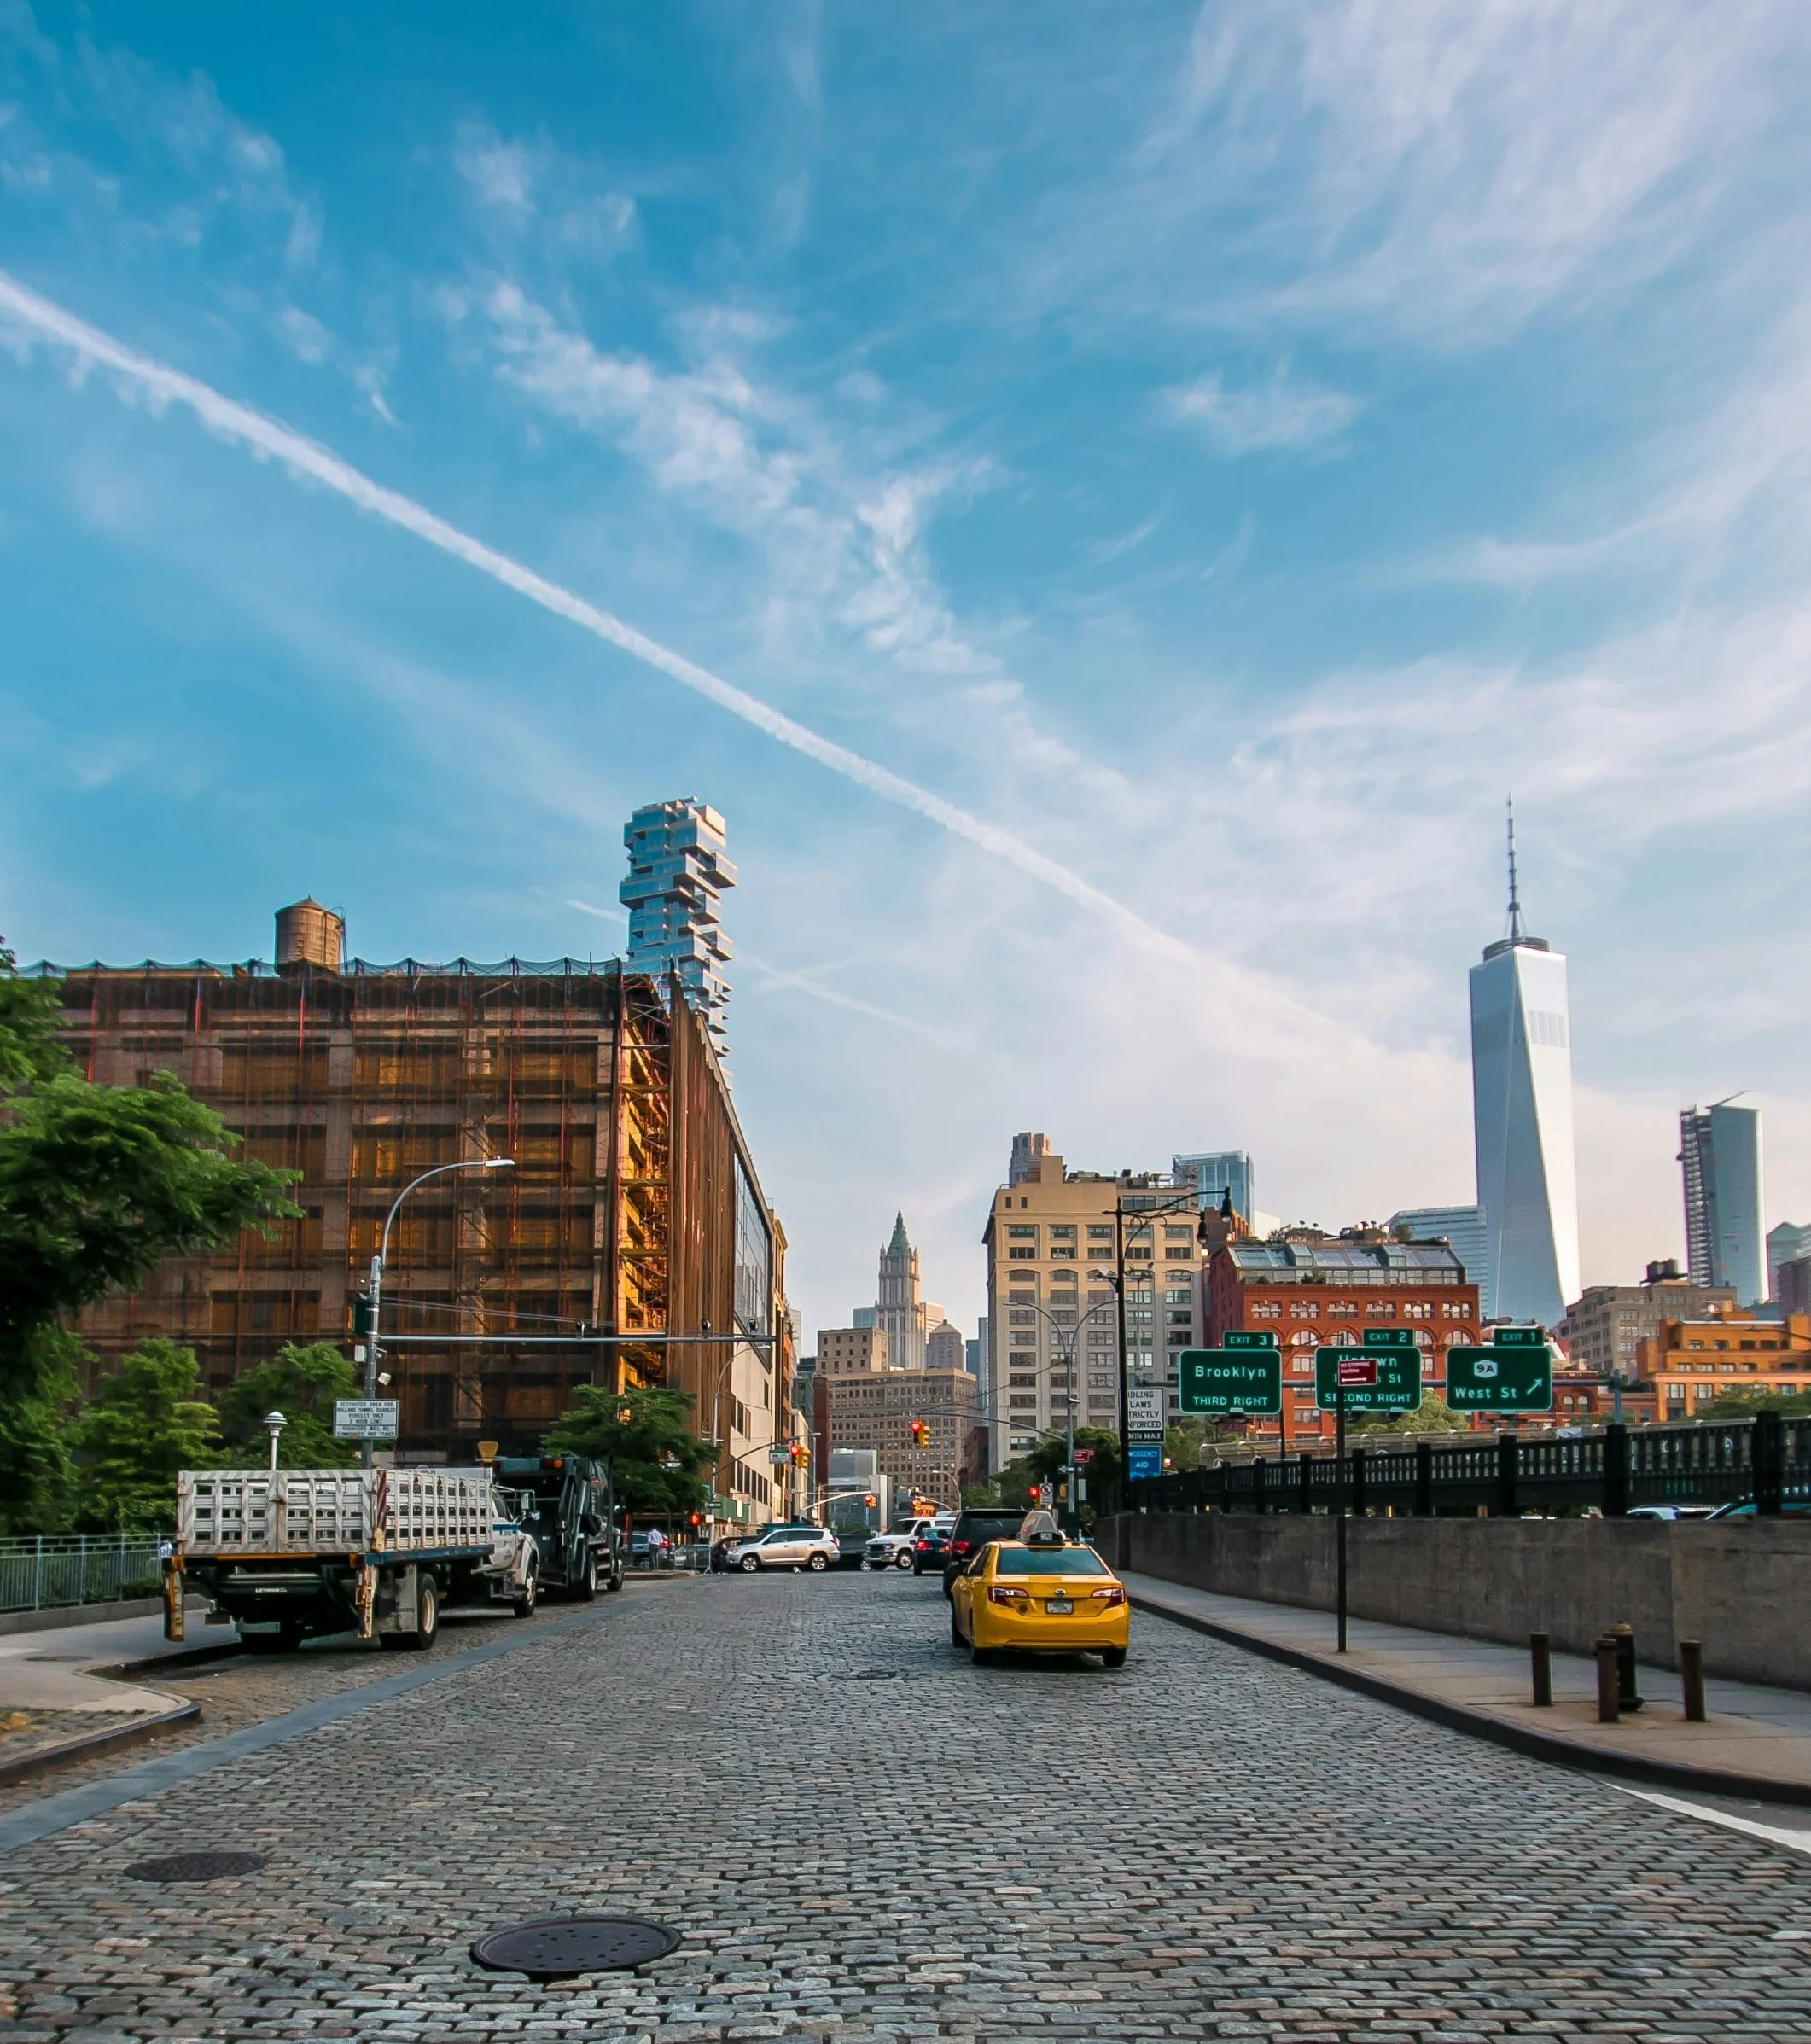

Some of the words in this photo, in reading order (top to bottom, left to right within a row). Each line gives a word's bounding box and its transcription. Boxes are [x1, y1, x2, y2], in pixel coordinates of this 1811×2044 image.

[1230, 1336, 1251, 1344] EXIT
[1259, 1335, 1267, 1346] 3
[1399, 1331, 1407, 1342] 2
[1502, 1333, 1523, 1342] EXIT
[1529, 1331, 1535, 1342] 1
[1195, 1366, 1267, 1381] Brooklyn
[1476, 1364, 1495, 1373] 9A
[1389, 1373, 1402, 1383] St
[1127, 1390, 1154, 1399] IDLING
[1325, 1393, 1371, 1402] SEOND
[1377, 1393, 1412, 1402] RIGHT
[1453, 1387, 1492, 1399] West
[1500, 1387, 1517, 1399] St
[1193, 1396, 1227, 1406] THIRD
[1233, 1396, 1268, 1406] RIGHT
[1127, 1410, 1160, 1418] TRICTLY
